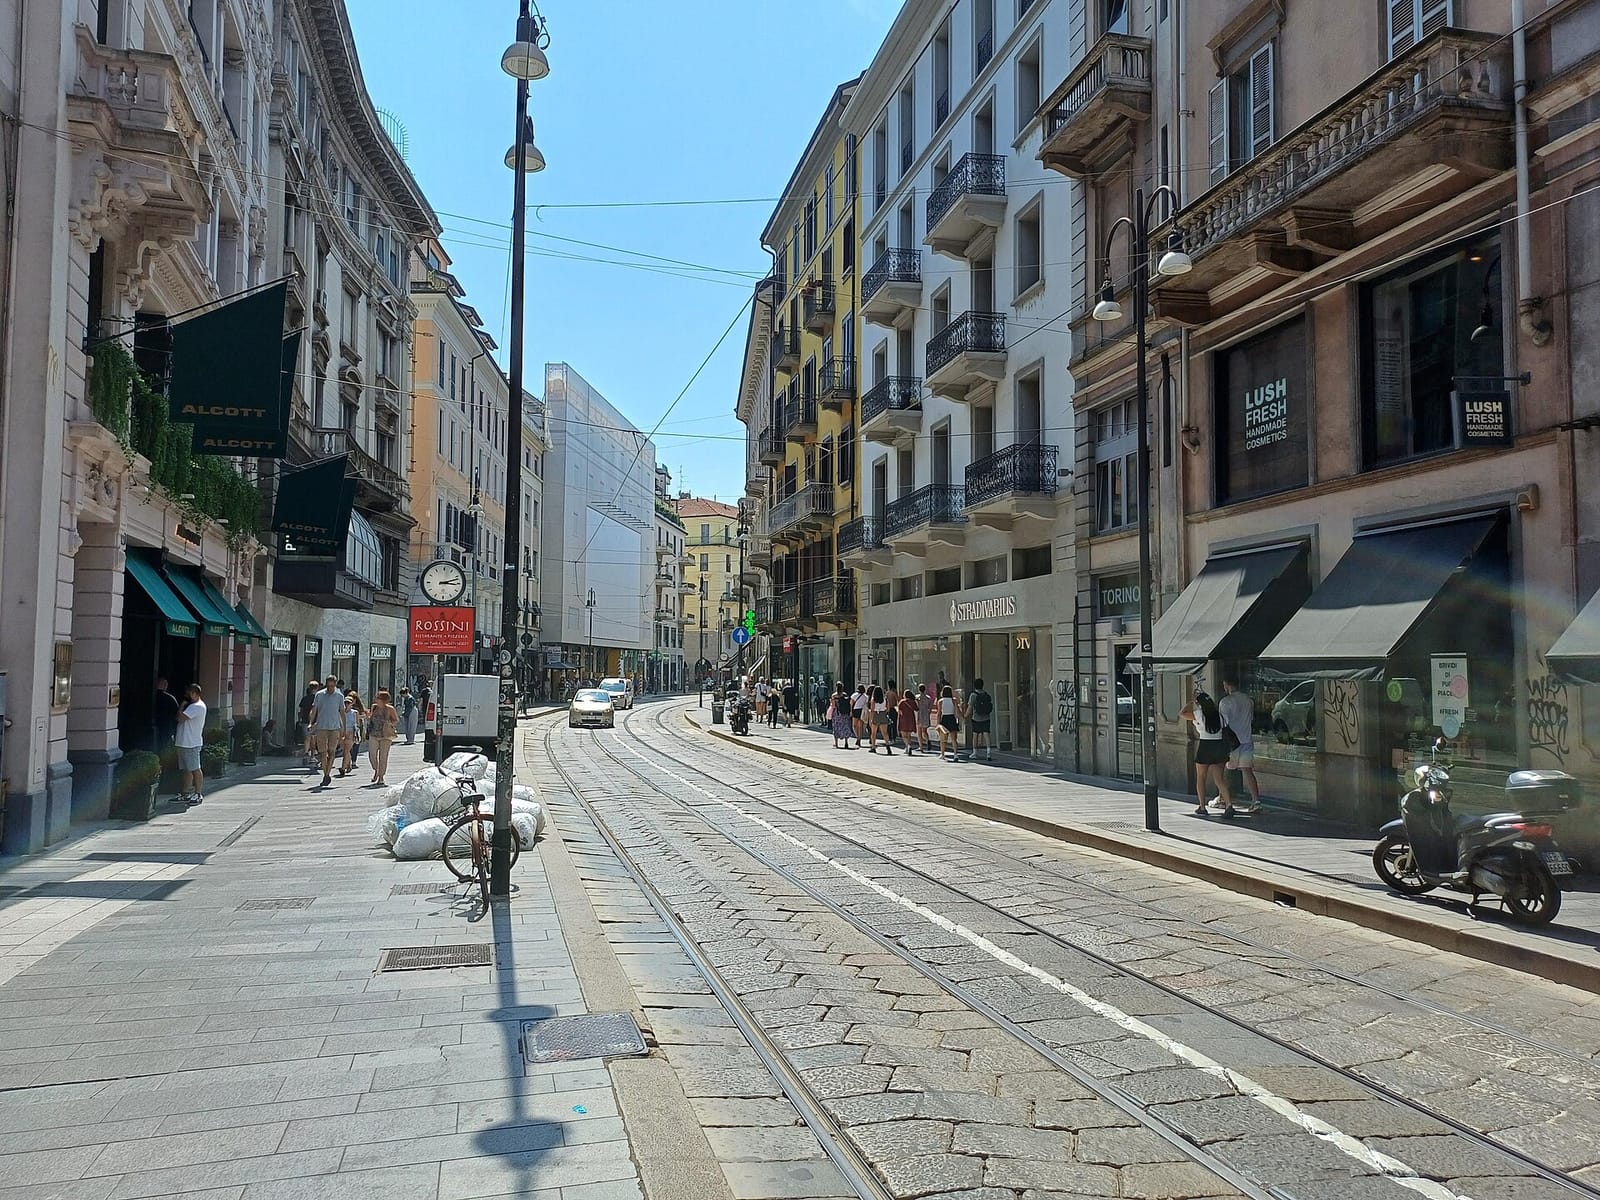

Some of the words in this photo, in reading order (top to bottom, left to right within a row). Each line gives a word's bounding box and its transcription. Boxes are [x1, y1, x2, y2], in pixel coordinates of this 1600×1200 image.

[1245, 377, 1287, 410] LUSH
[181, 404, 267, 418] ALCOTT
[1246, 398, 1287, 428] FRESH
[1465, 401, 1503, 413] LUSH
[1466, 413, 1503, 423] FRESH
[1246, 417, 1287, 439] HANDMADE
[202, 438, 276, 449] ALCOTT
[1246, 429, 1287, 450] COSMETICS
[279, 522, 329, 534] ALCOTT
[1101, 585, 1140, 606] TORINO
[957, 595, 1015, 621] STRADIVARIUS
[415, 620, 469, 632] ROSSINI
